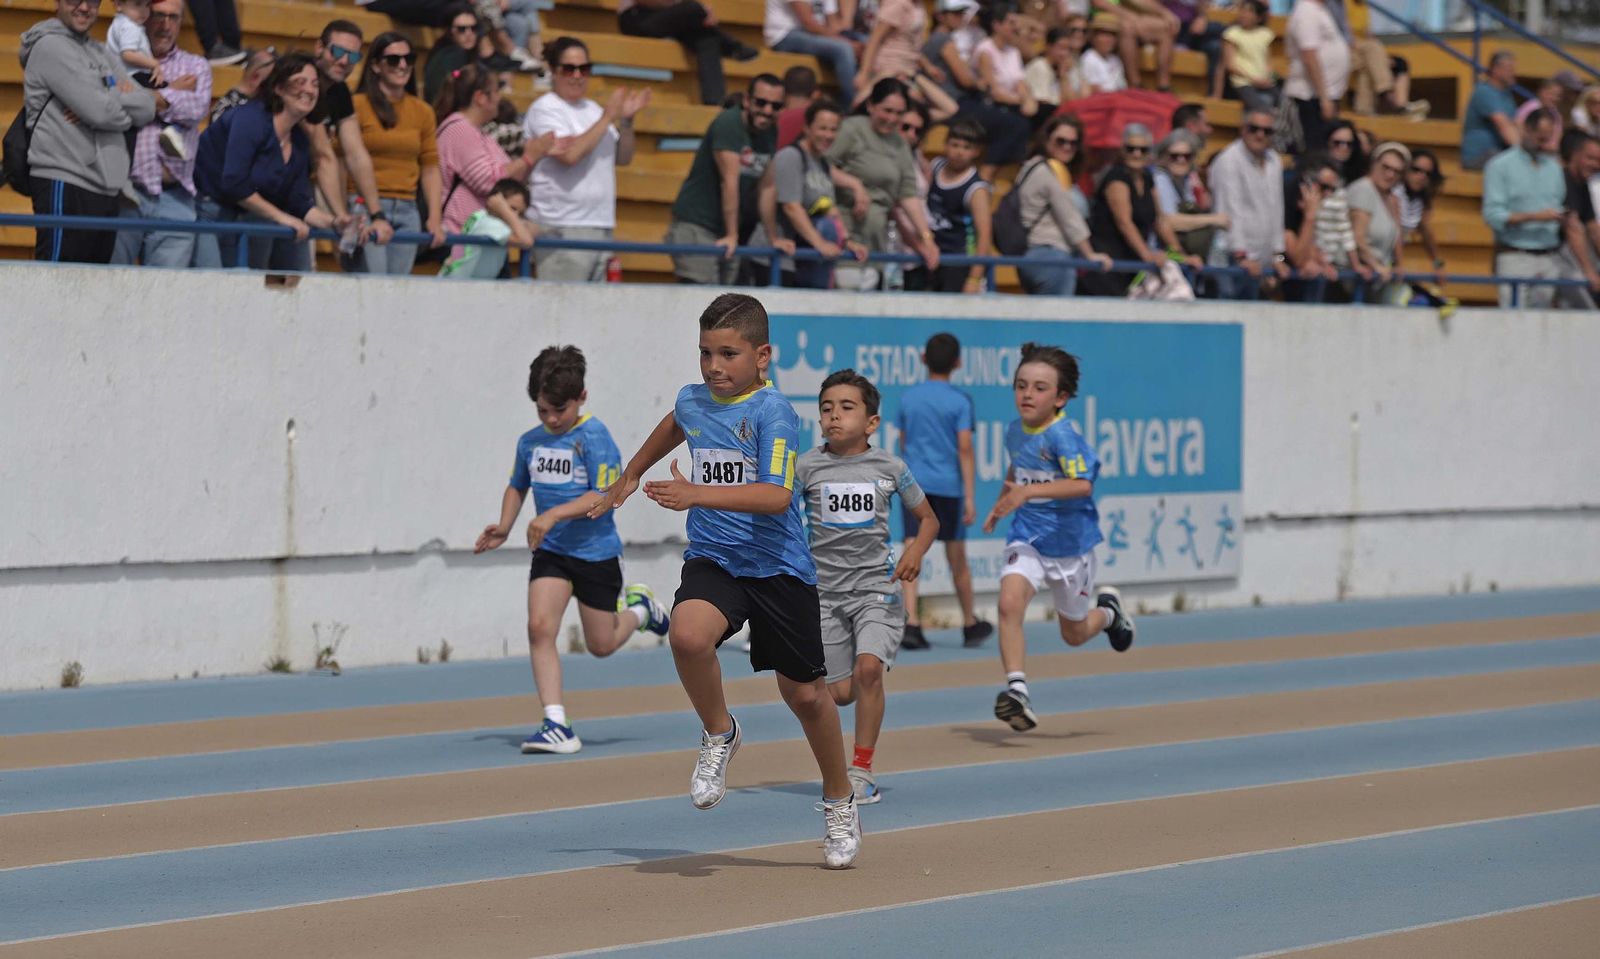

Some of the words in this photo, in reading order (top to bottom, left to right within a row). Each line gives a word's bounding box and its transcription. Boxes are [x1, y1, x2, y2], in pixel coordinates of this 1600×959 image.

[856, 344, 929, 386] ESTADI
[951, 346, 1021, 387] UNICI
[1071, 394, 1206, 480] lavera
[537, 457, 570, 475] 3440
[702, 461, 744, 484] 3487
[828, 493, 874, 512] 3488
